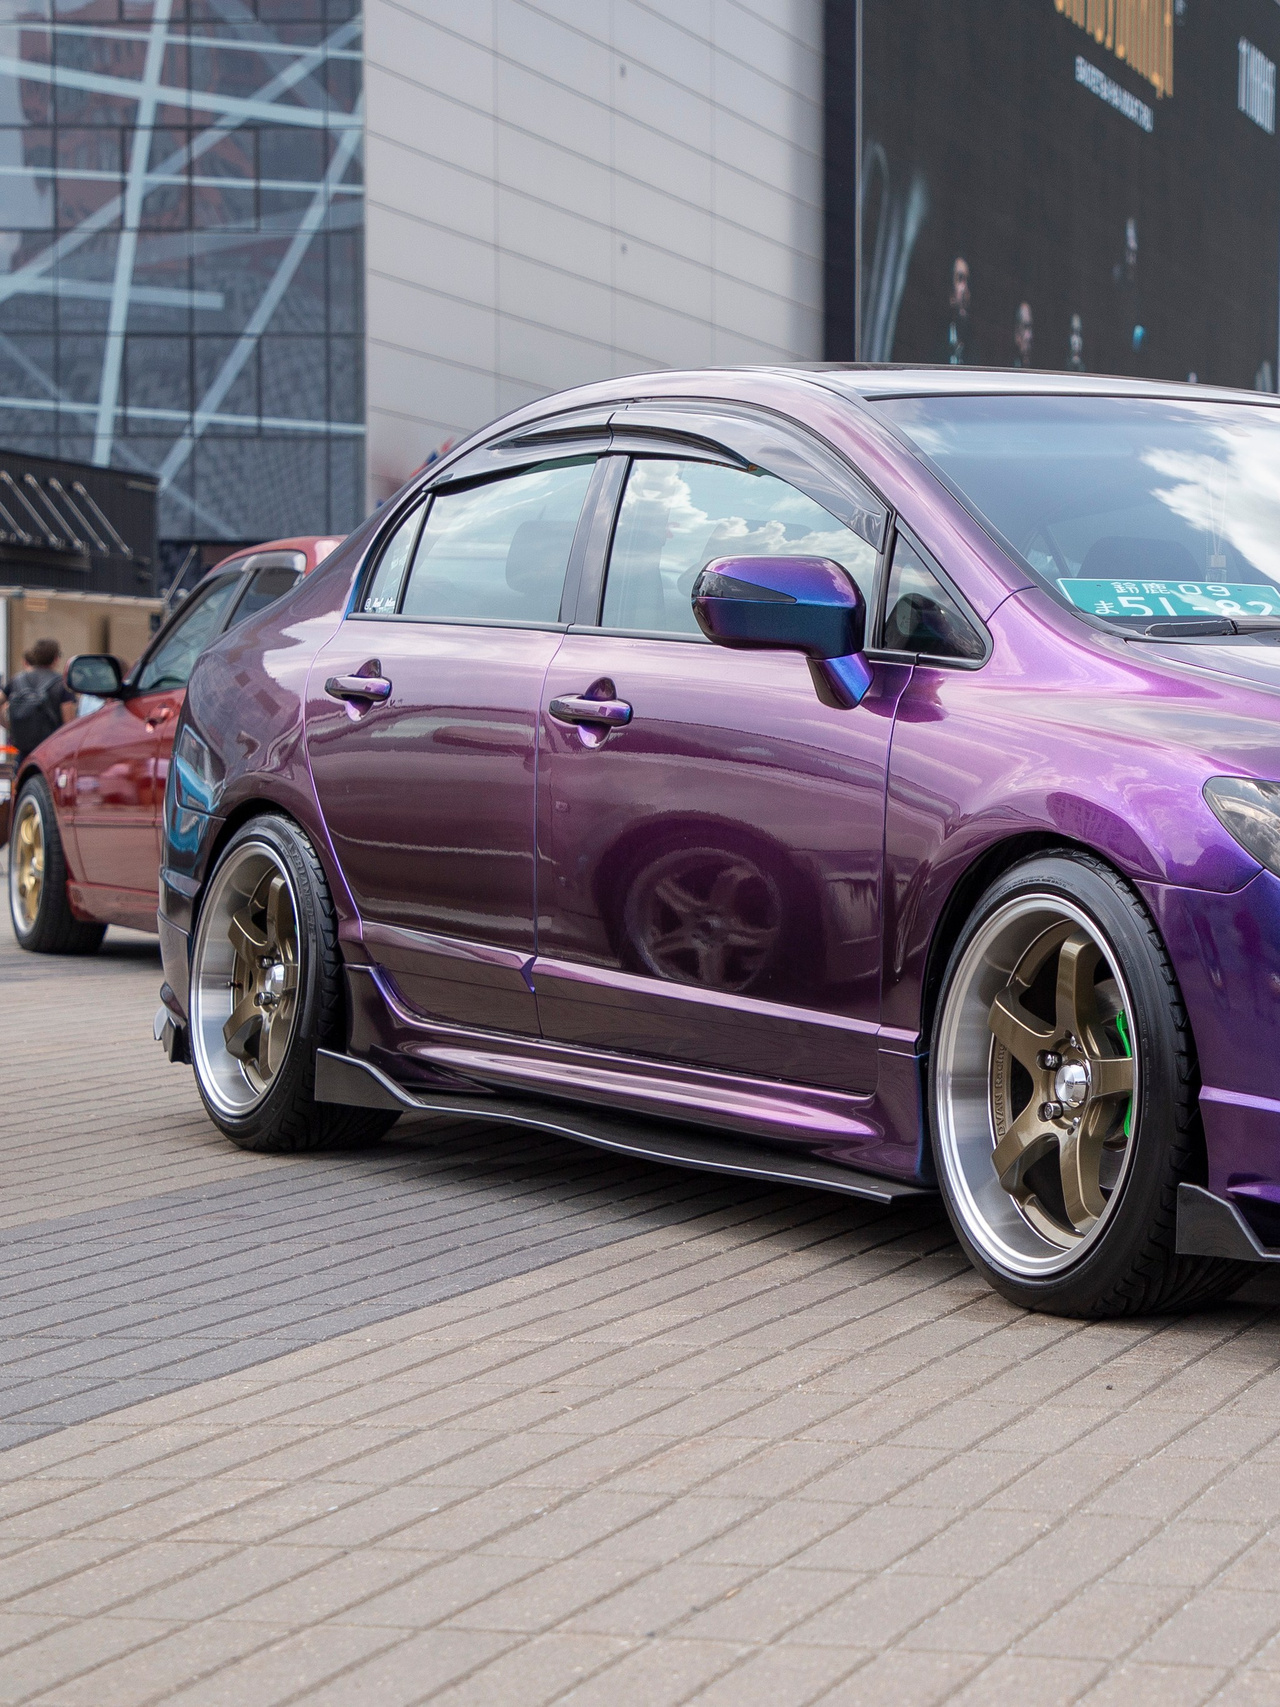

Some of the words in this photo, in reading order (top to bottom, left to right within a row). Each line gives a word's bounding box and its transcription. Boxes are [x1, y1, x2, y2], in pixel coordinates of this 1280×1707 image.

[1110, 581, 1172, 595] 鈴鹿
[1178, 583, 1231, 597] 09
[994, 1092, 1006, 1140] DVAN
